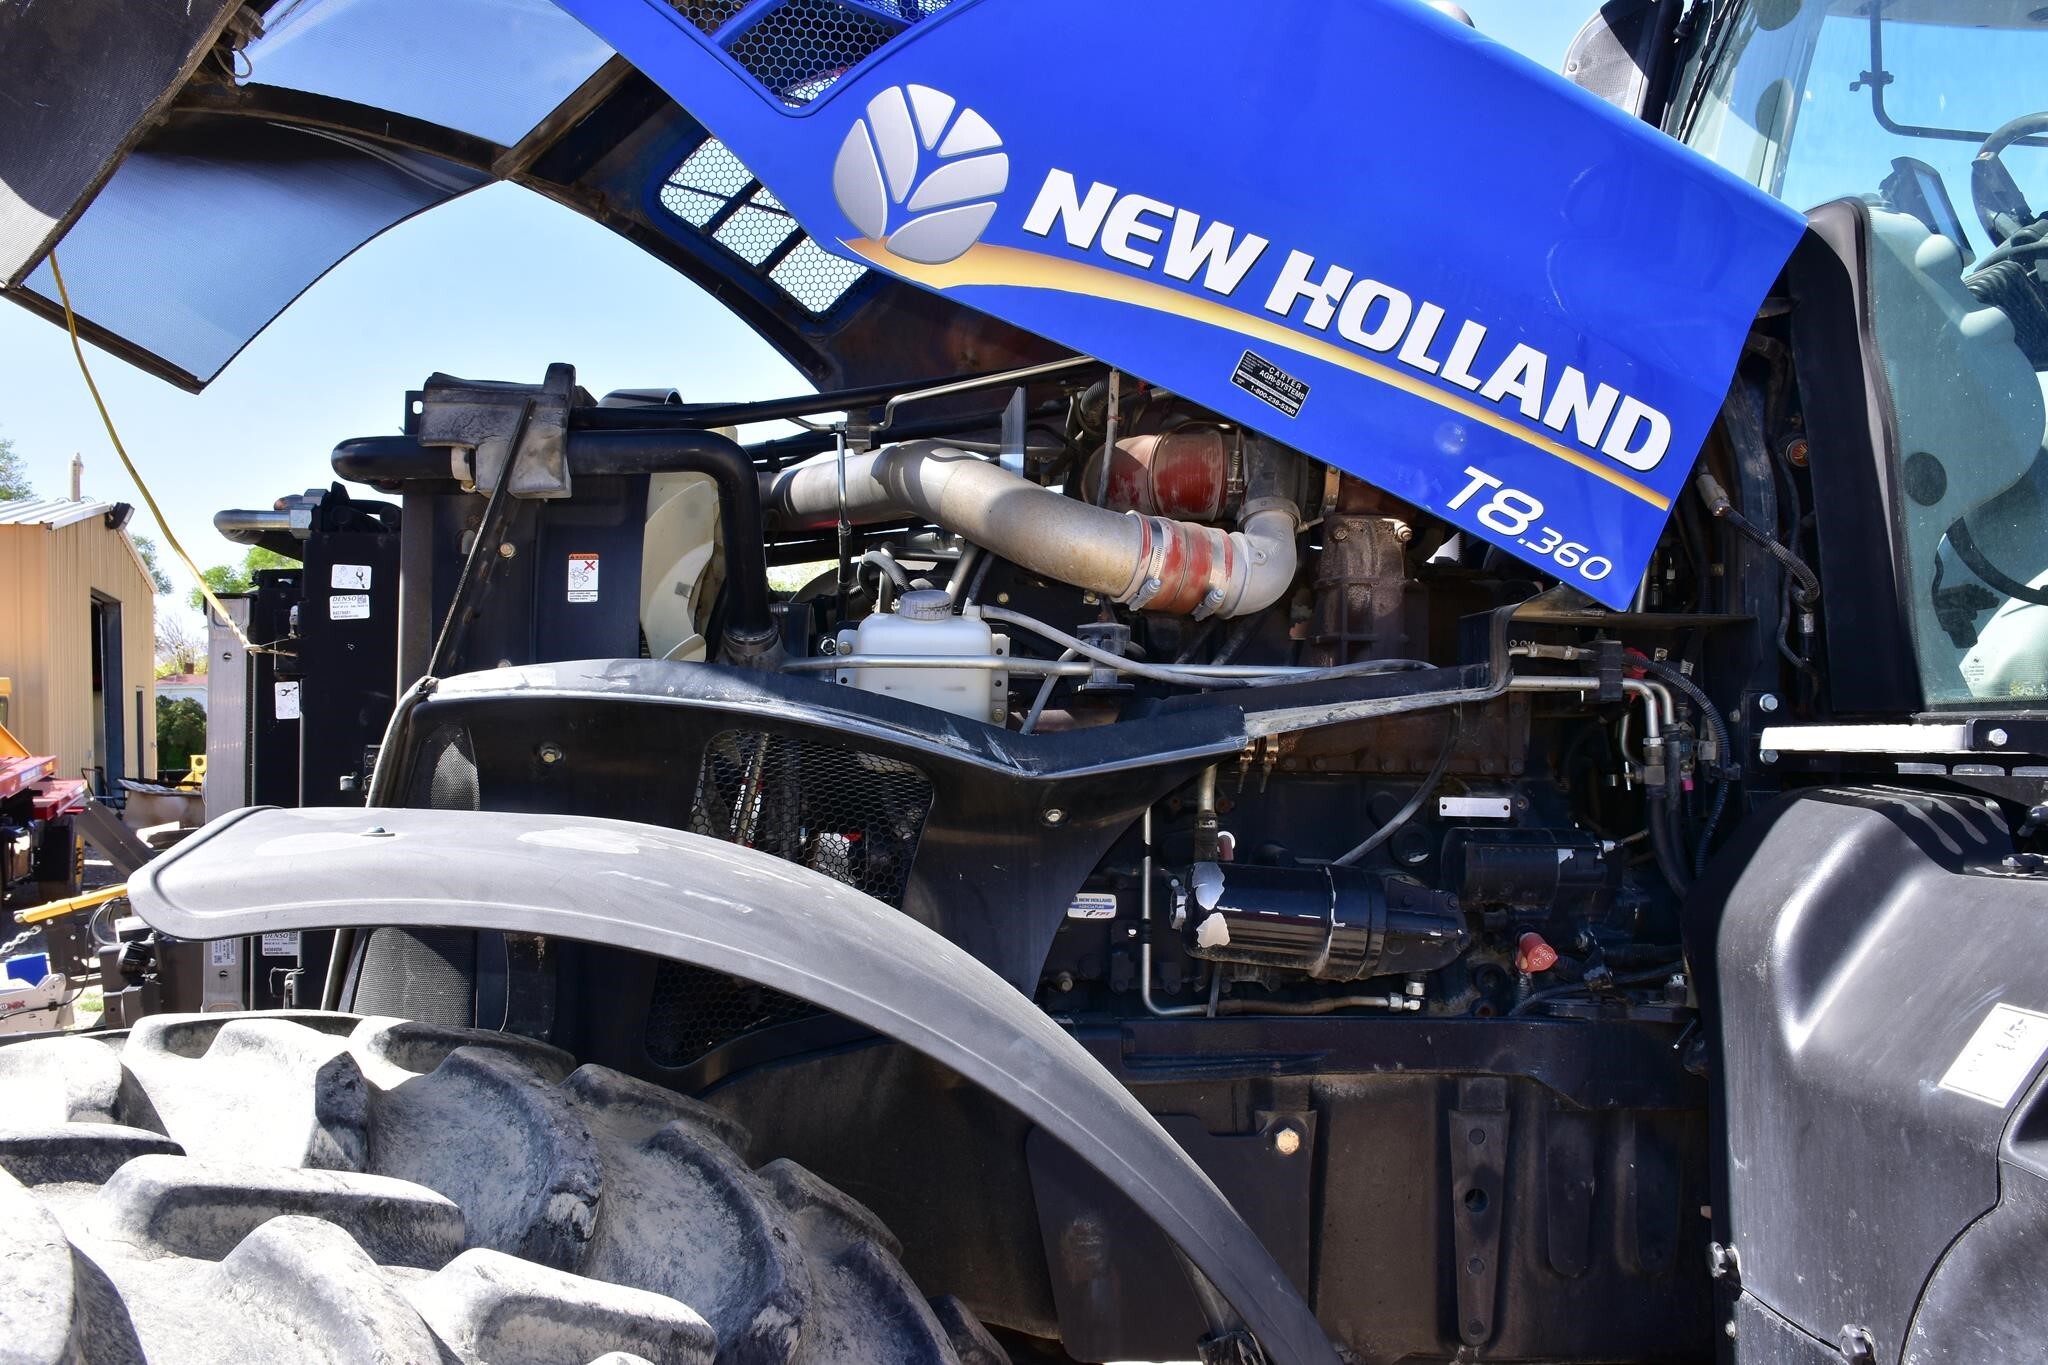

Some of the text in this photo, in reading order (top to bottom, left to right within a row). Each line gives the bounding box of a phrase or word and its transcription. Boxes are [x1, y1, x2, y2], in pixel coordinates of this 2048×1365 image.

[1022, 168, 1672, 473] NEW HOLLAND
[1259, 370, 1305, 400] AGRI-SYSTEMS
[1269, 367, 1302, 390] CARTER
